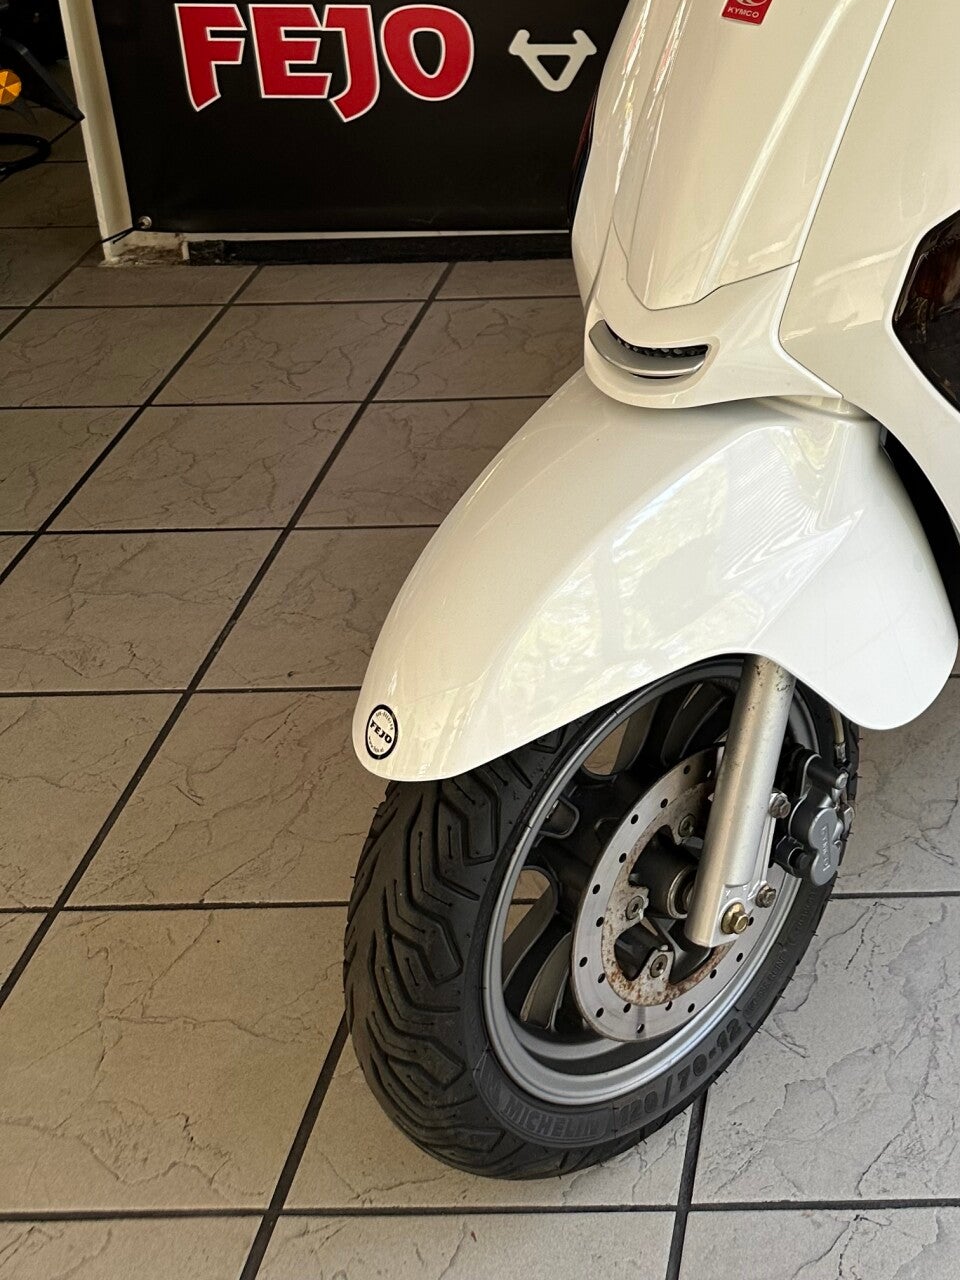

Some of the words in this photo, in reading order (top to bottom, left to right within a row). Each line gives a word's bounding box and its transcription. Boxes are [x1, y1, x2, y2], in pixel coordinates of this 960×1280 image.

[727, 6, 759, 18] KYMCO
[174, 3, 474, 123] FEJO
[370, 719, 393, 744] FEJO
